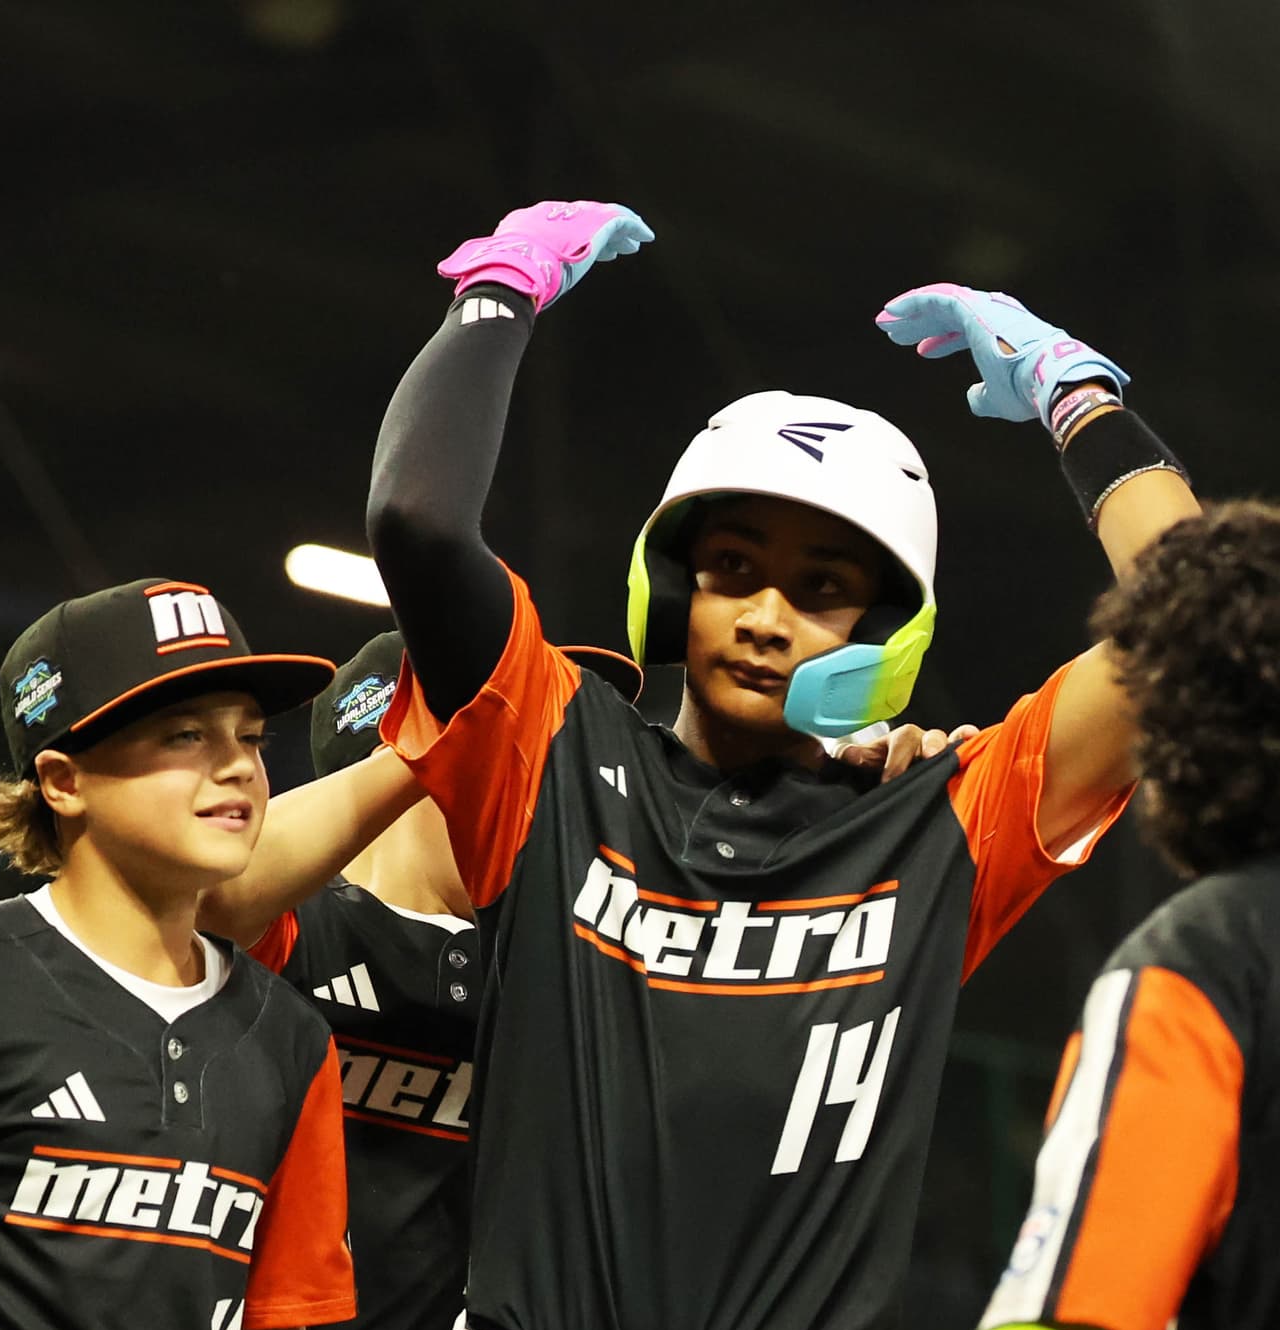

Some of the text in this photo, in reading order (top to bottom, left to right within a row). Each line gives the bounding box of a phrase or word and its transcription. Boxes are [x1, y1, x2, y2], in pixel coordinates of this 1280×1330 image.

[336, 701, 367, 731] WORLD
[365, 680, 397, 709] SERIES
[769, 1005, 902, 1176] 14
